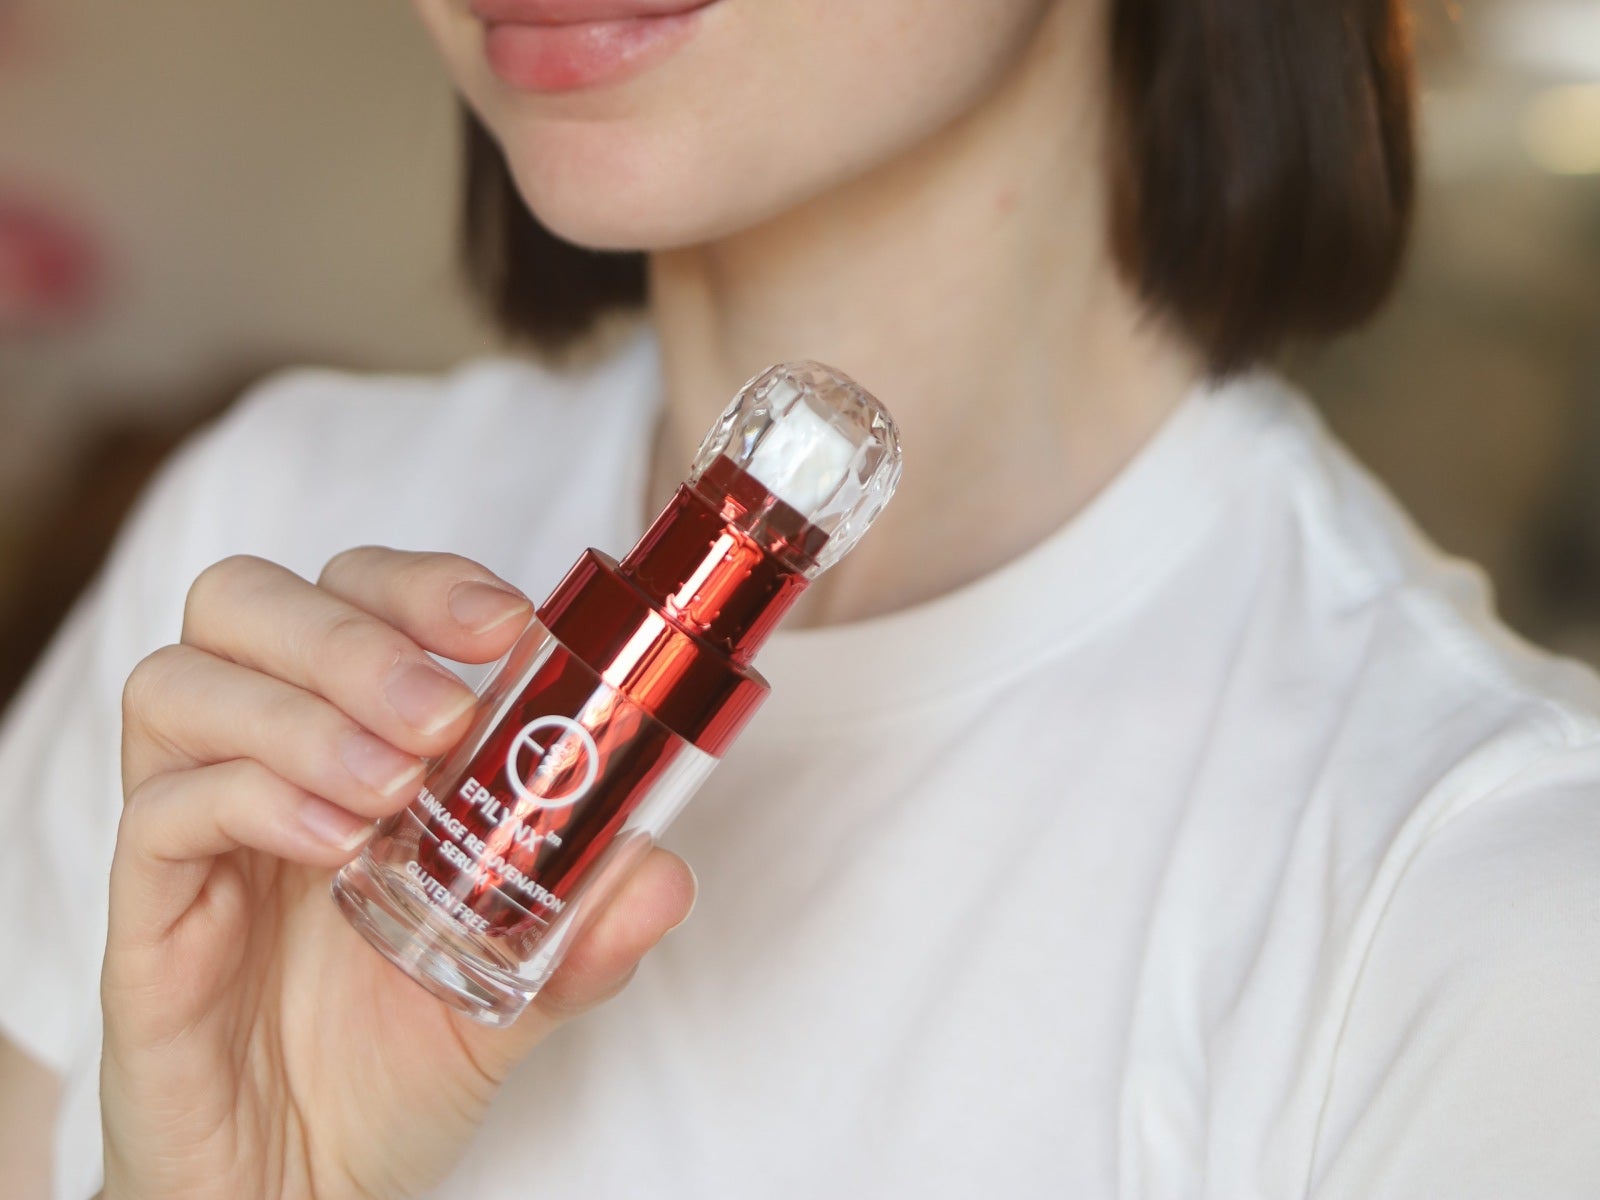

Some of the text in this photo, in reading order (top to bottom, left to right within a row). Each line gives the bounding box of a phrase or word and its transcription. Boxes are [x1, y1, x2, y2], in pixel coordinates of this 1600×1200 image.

[417, 786, 469, 841] ILINKAGE
[463, 833, 566, 913] REUVENATION
[460, 777, 544, 852] EPILYNX
[405, 860, 456, 907] GLUTEN
[453, 903, 490, 934] FREE
[439, 840, 489, 885] SERUM
